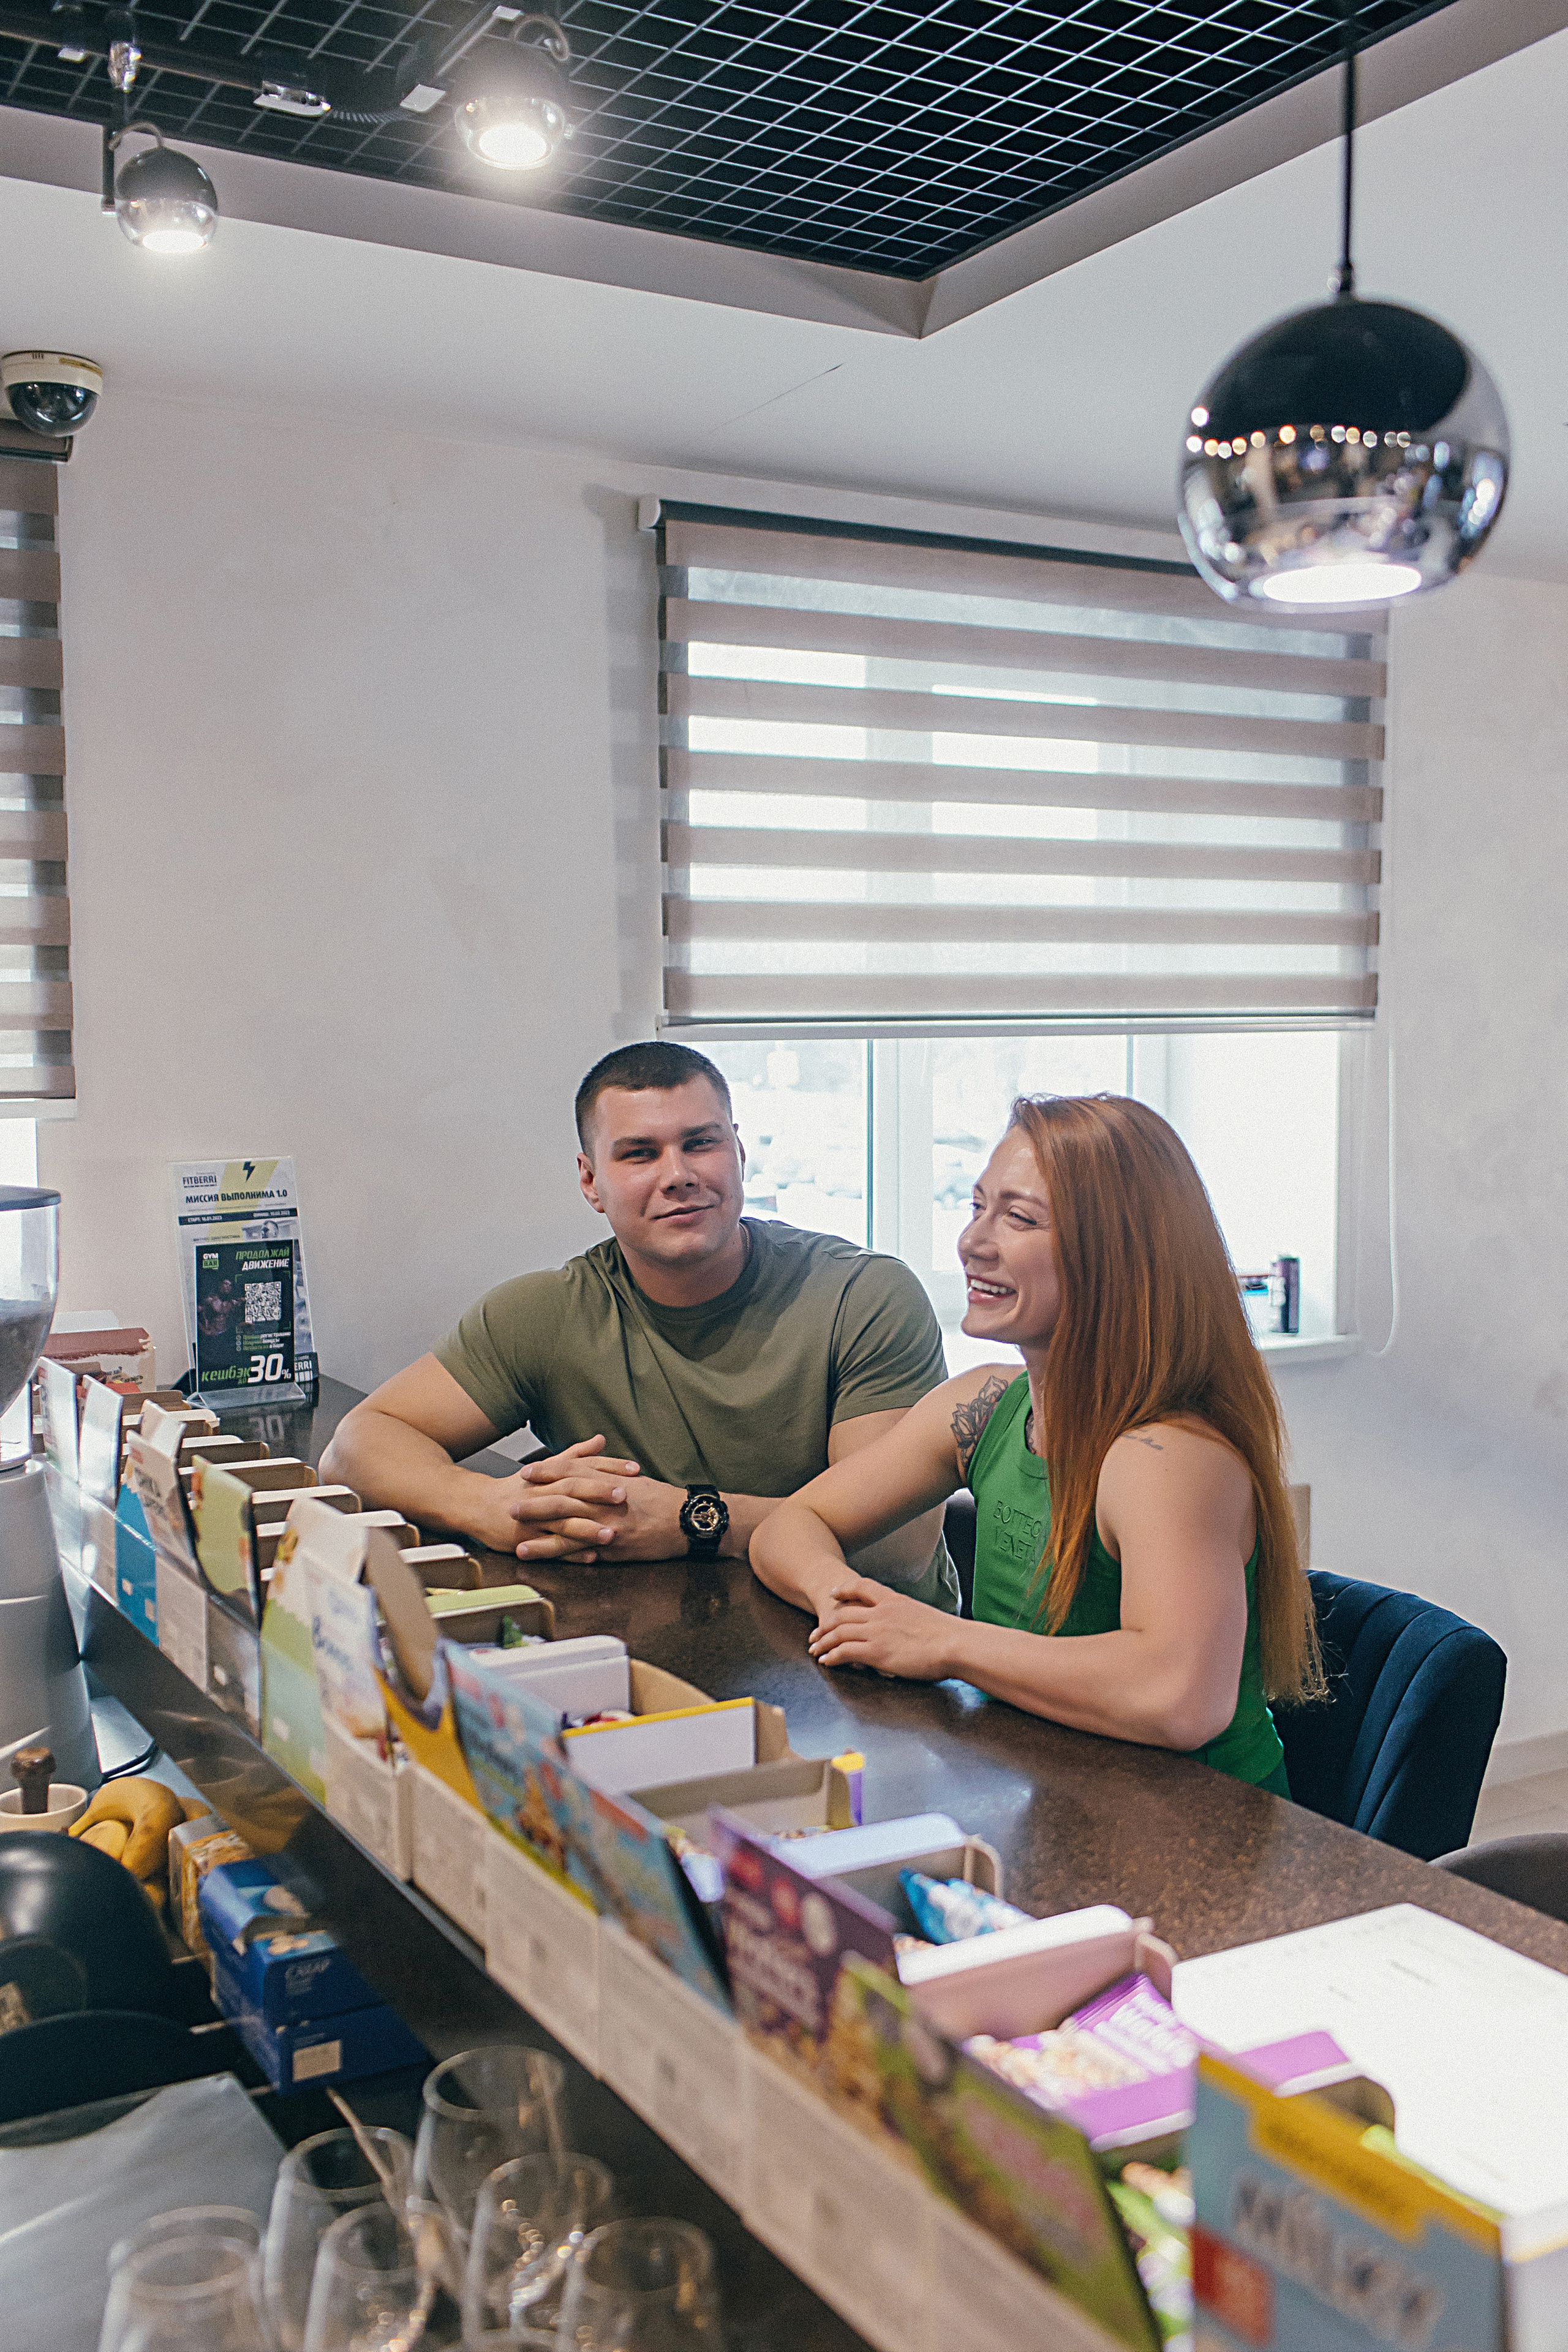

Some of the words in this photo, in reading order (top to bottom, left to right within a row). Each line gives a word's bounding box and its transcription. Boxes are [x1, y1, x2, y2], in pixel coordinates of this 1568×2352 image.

[183, 1175, 217, 1185] FITBERRI
[186, 1194, 219, 1204] МИССИЯ
[221, 1190, 275, 1201] ВЫПОЛНИМА
[276, 1189, 287, 1197] 1.0
[235, 1247, 290, 1260] ПРОДОЛЖАЙ
[241, 1258, 290, 1271] ДВИЖЕНИЕ
[294, 1360, 312, 1370] ERRI
[202, 1365, 251, 1382] кешбэк
[993, 1500, 1042, 1538] BOTTEG
